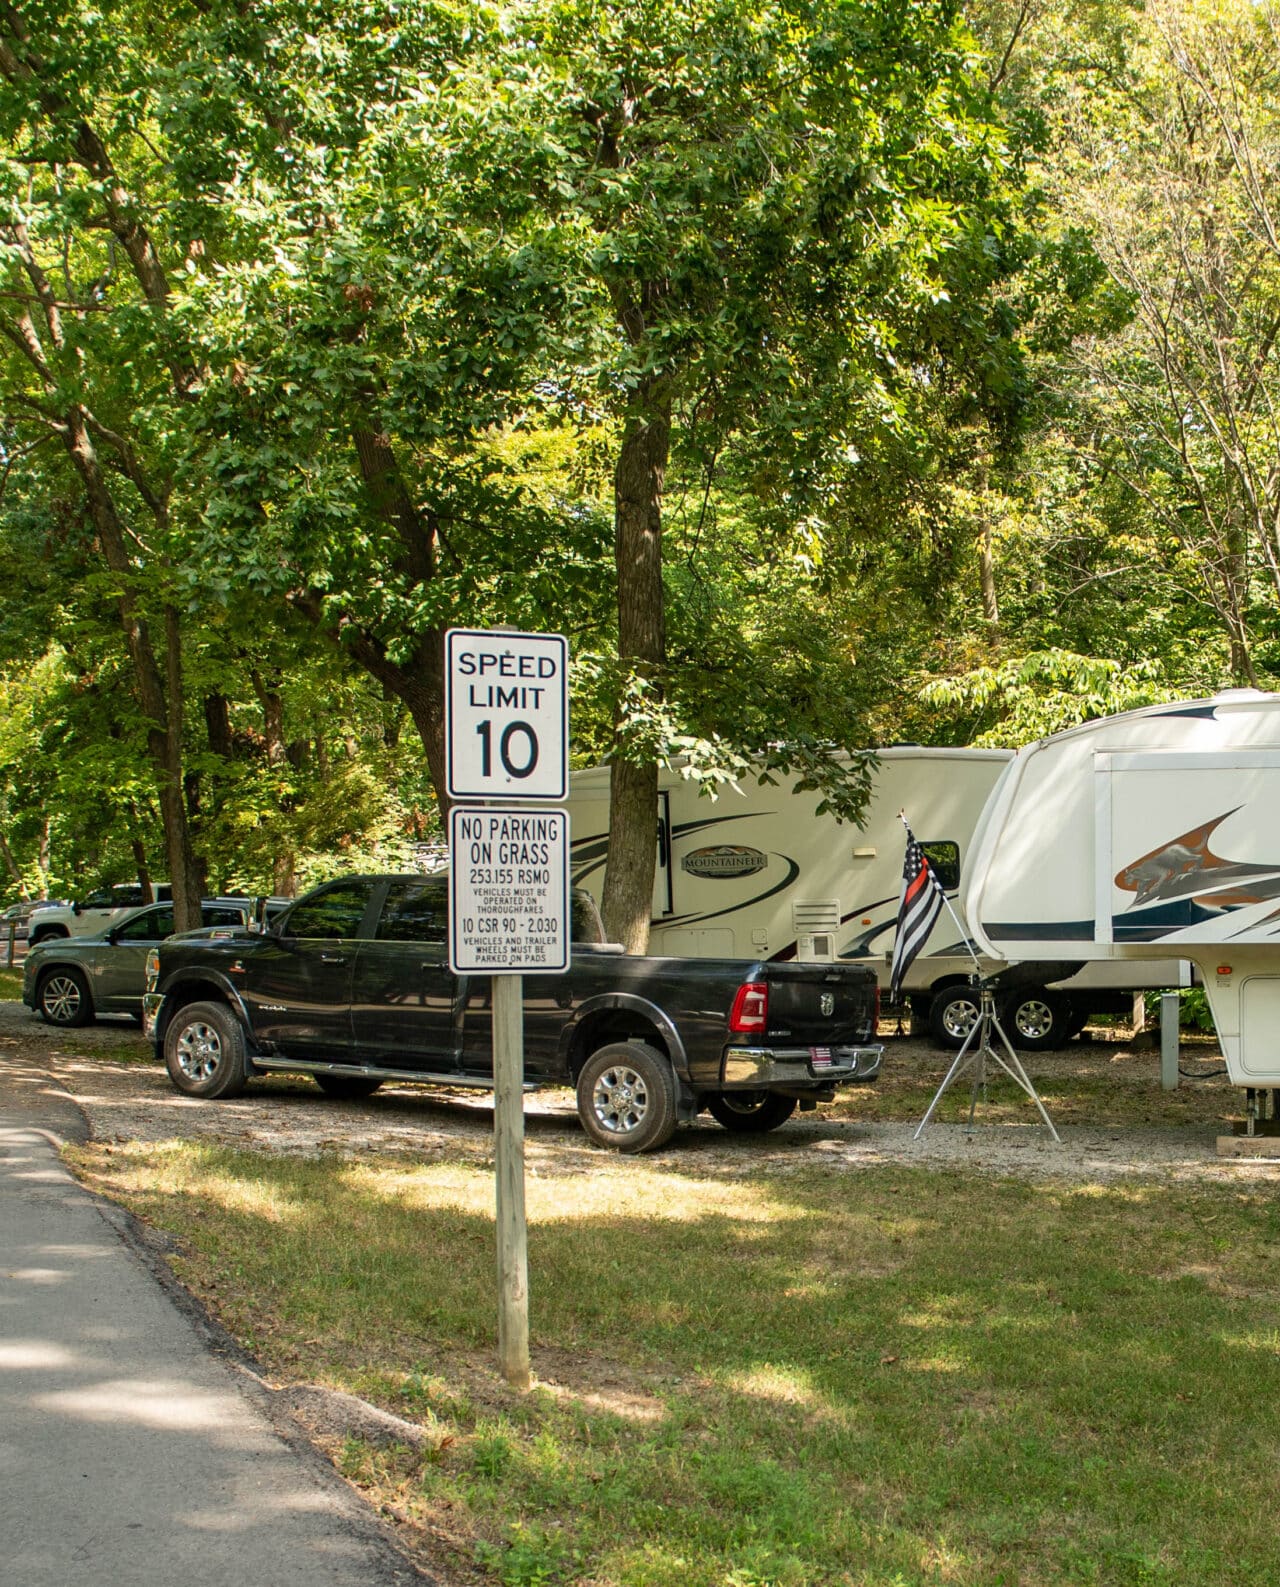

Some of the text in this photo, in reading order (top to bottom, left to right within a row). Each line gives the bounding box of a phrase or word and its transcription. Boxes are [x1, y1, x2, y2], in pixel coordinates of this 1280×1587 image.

[458, 652, 556, 679] SPEED
[469, 684, 545, 710] LIMIT
[476, 720, 539, 779] 10
[461, 817, 558, 841] NO PARKING
[470, 842, 549, 865] ON GRASS
[685, 857, 764, 868] MOUNTAINEER
[470, 869, 550, 884] 253.155 RSMO
[473, 888, 547, 897] VEHICLES MUST BE
[483, 897, 537, 905] OPERATED ON
[477, 906, 544, 914] THOROUGHFARES
[462, 918, 474, 933] 10
[478, 918, 499, 933] CSR
[502, 918, 516, 933] 90
[528, 918, 558, 933] 2.030
[463, 937, 557, 945] VEHICLES AND TRAILER
[476, 946, 545, 954] WHEELS MUST BE
[475, 955, 546, 963] PARKED ON PADS
